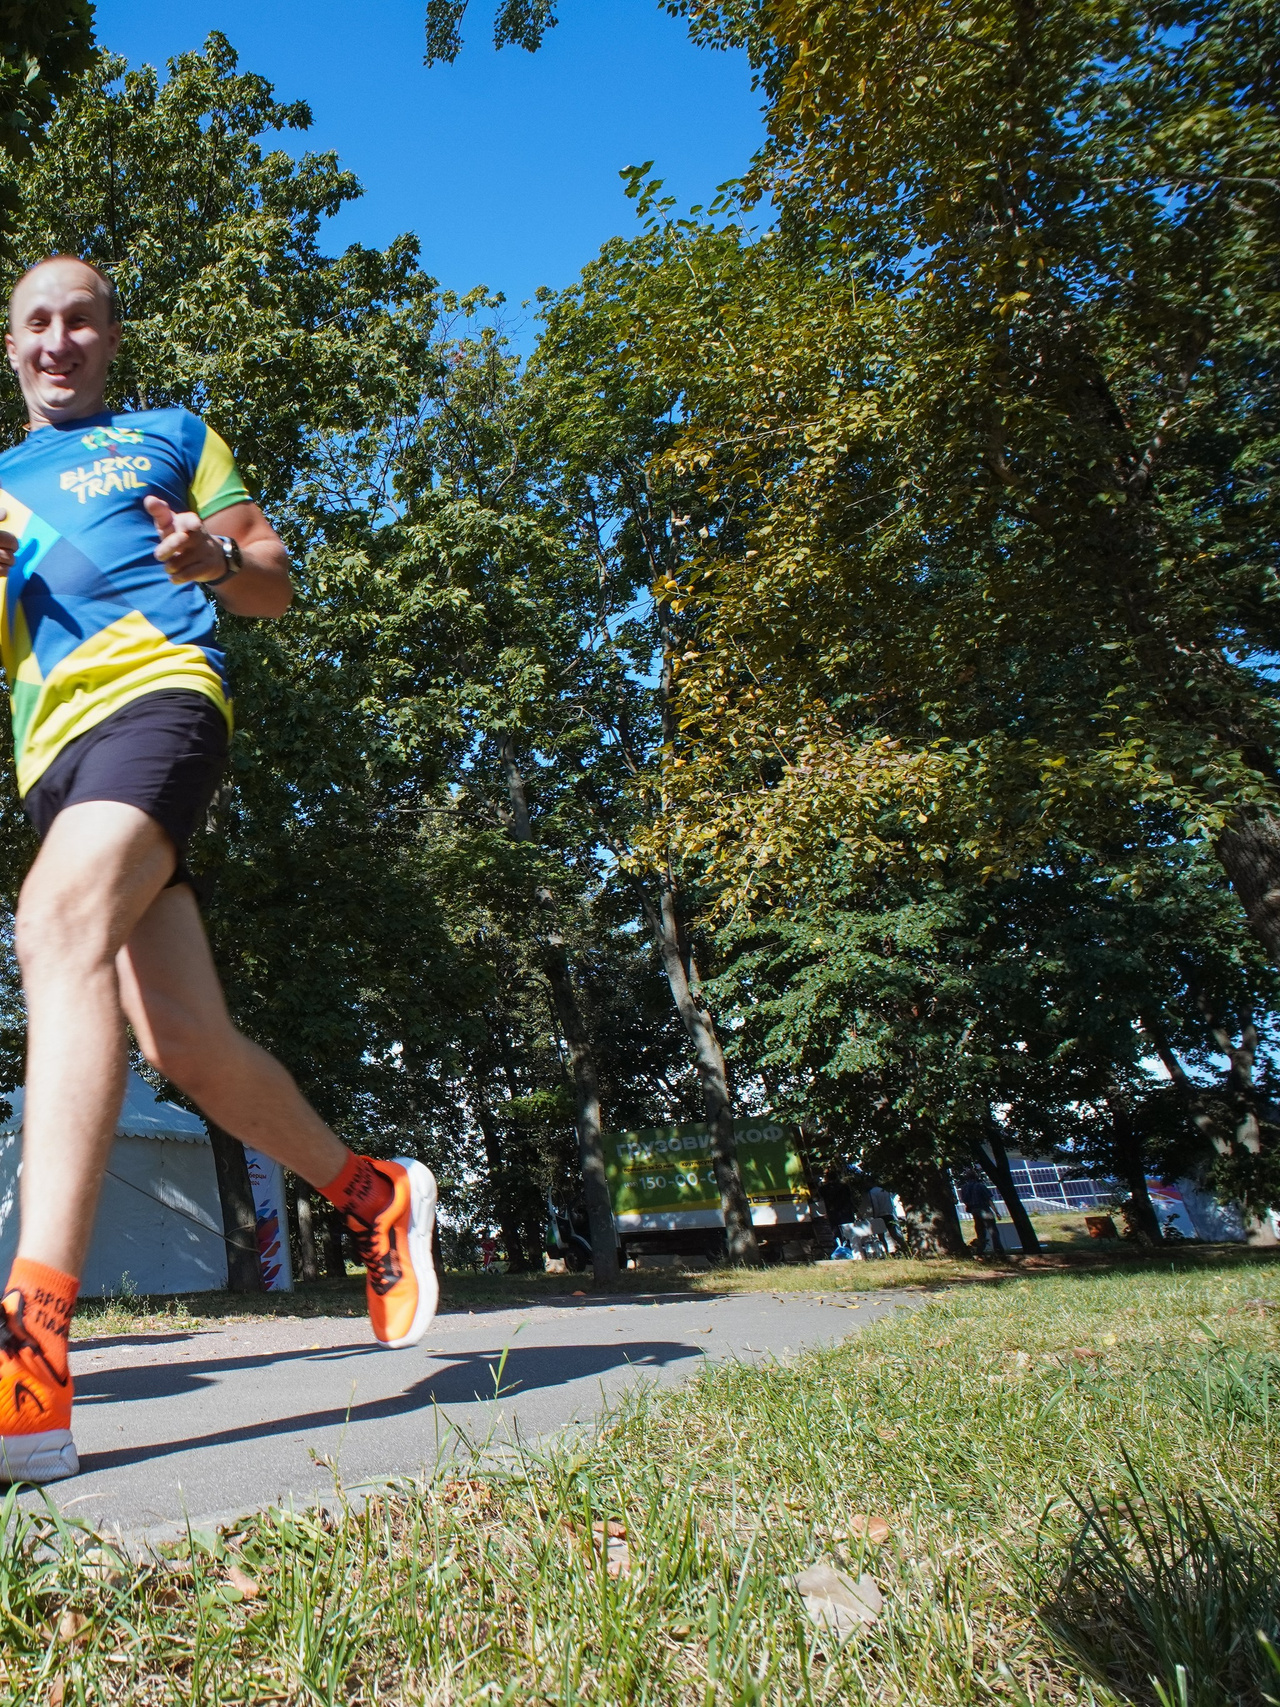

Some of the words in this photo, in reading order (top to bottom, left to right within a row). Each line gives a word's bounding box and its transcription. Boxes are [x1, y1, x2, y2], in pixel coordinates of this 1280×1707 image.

[60, 456, 151, 490] BLIZKO
[70, 470, 148, 504] TRAIL
[616, 1124, 784, 1160] грузовикоф
[248, 1172, 267, 1180] берцы
[639, 1170, 717, 1190] 150-00-0
